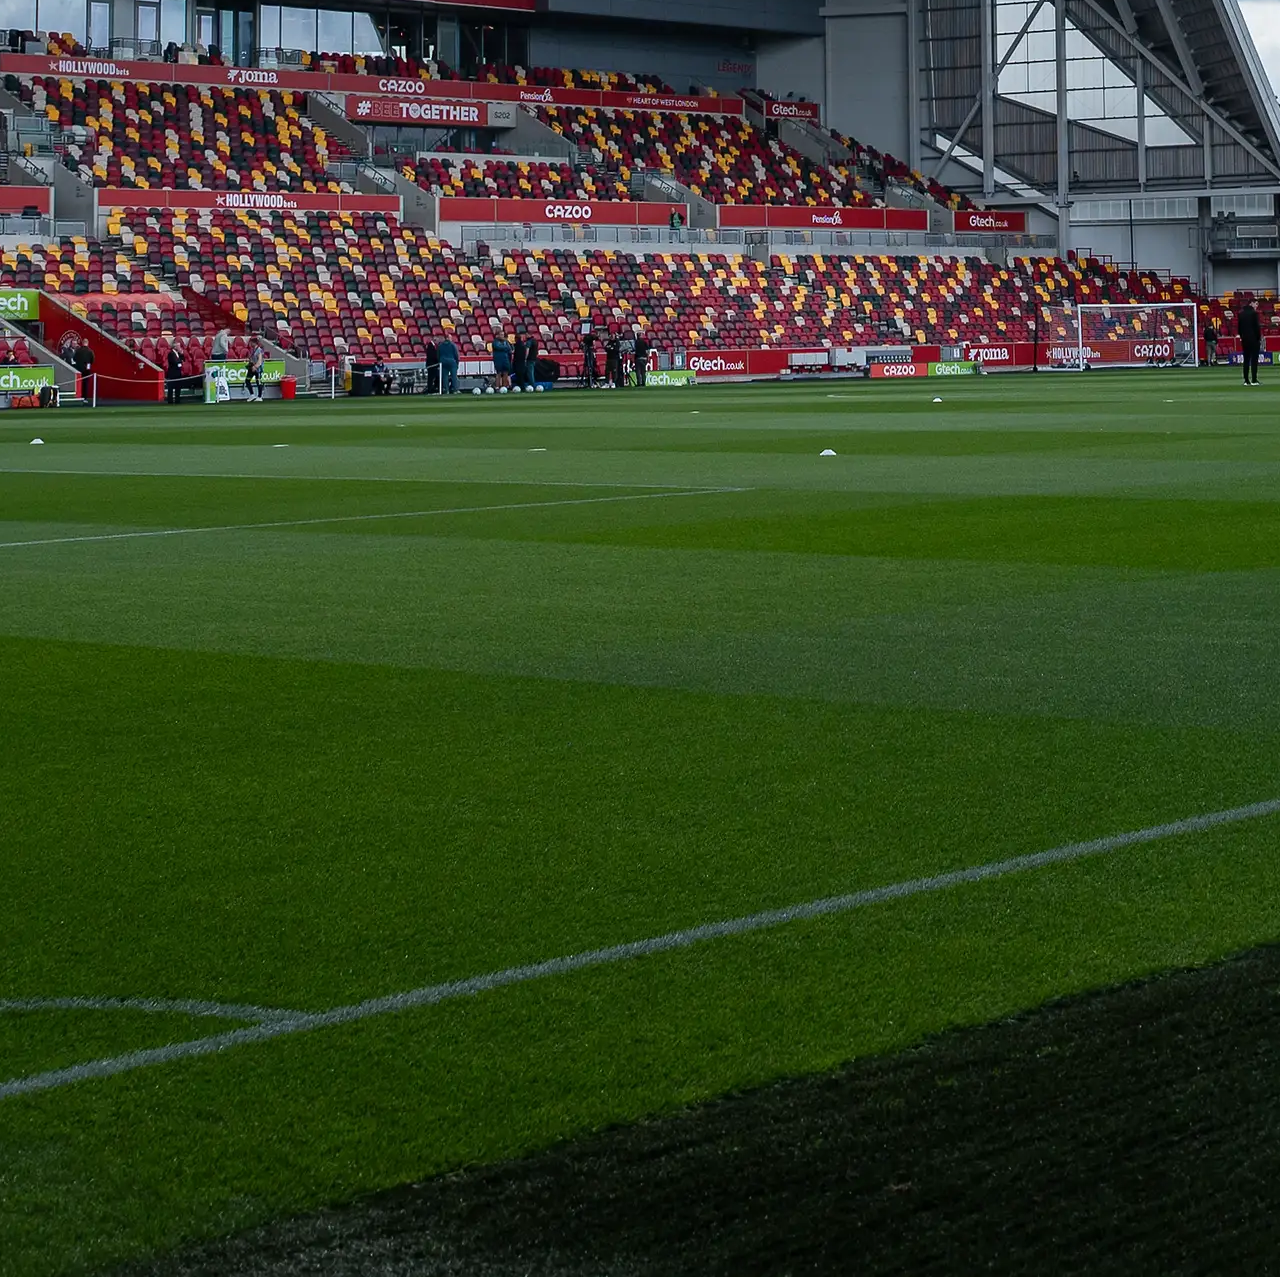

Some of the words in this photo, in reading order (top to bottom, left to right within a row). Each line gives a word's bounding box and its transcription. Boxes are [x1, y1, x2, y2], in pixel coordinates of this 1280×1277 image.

[675, 100, 699, 108] LONDON
[772, 103, 812, 117] Gtech.co.uk
[494, 111, 511, 120] S202
[969, 215, 1008, 229] Gtech.co.uk
[690, 356, 744, 371] Gtech.co.uk
[646, 372, 688, 386] tech.co.uk
